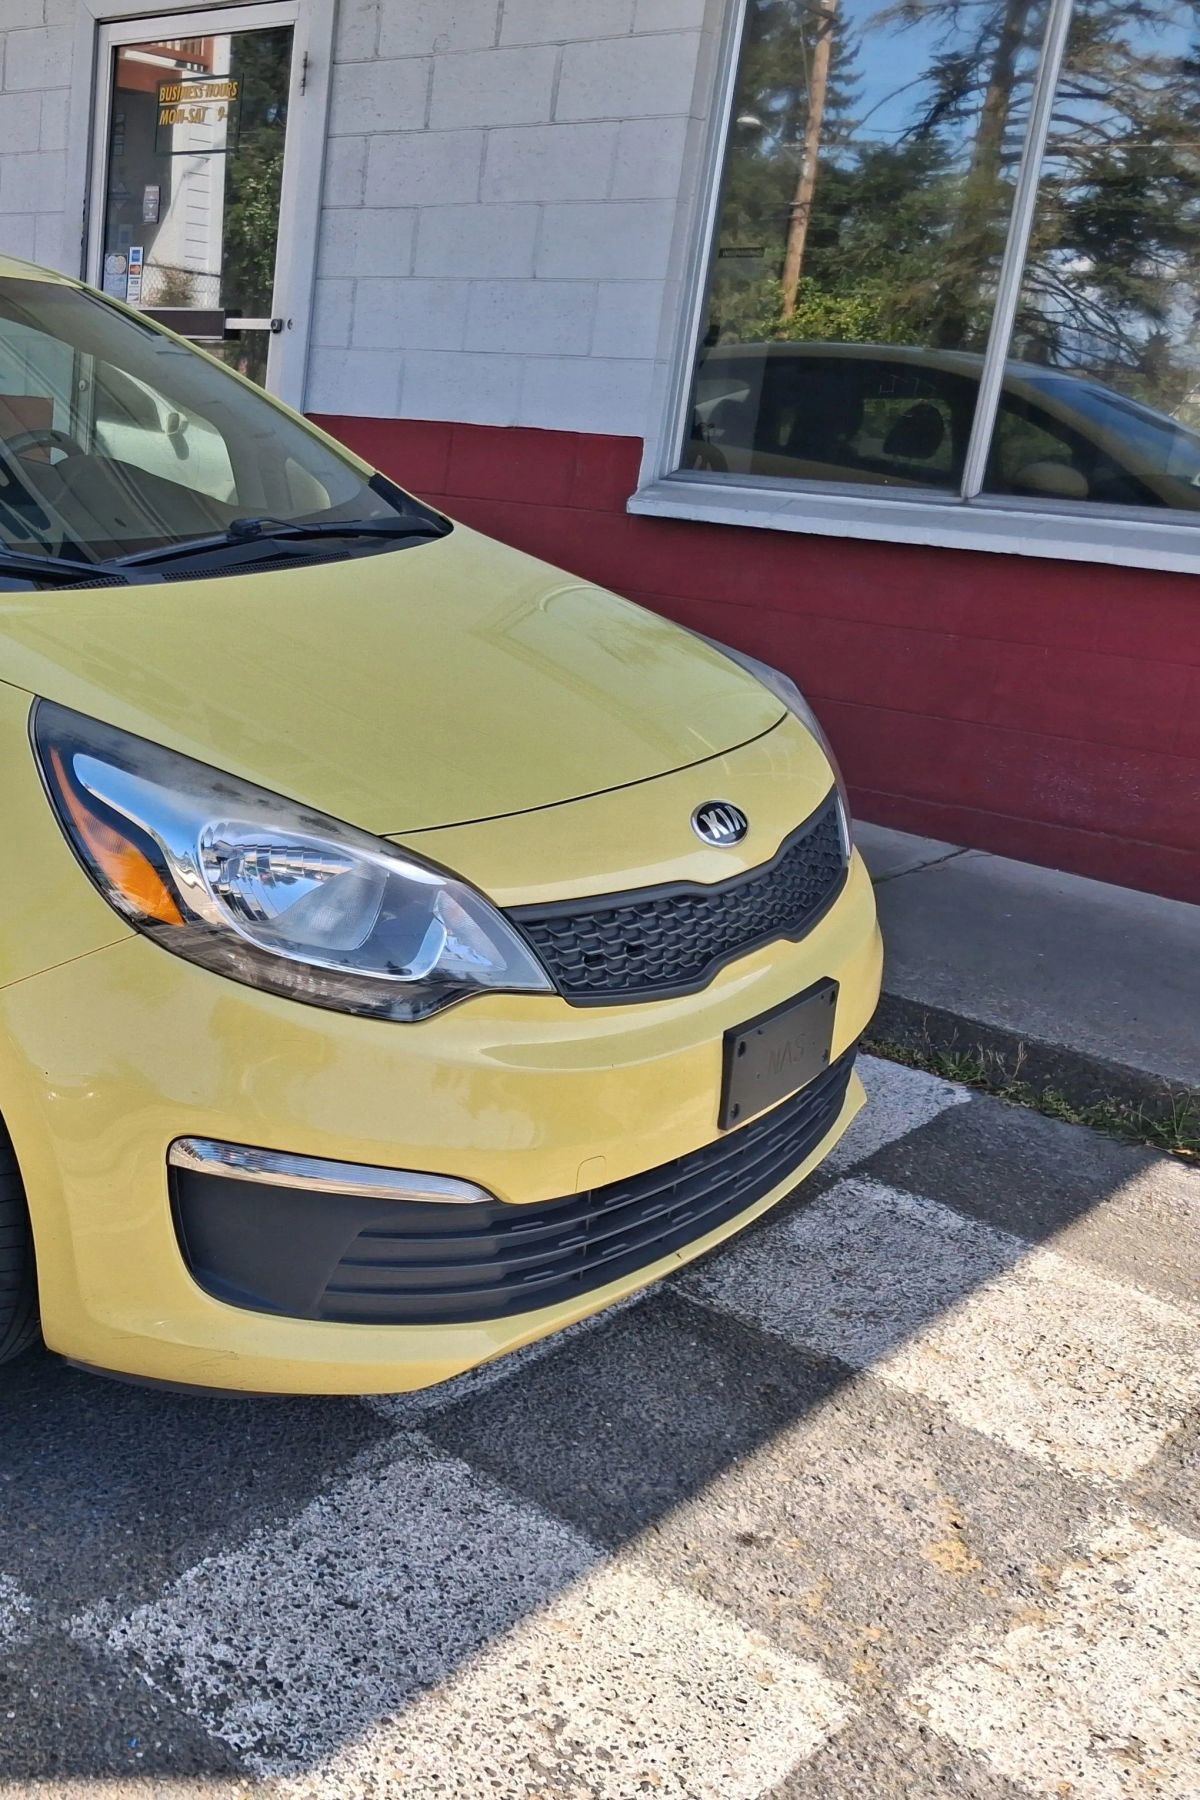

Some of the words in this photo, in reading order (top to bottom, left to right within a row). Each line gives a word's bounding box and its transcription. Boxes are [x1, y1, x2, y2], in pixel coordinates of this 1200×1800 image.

[159, 85, 206, 102] BUSINESS
[206, 82, 239, 99] HOURS
[699, 804, 747, 839] KIA
